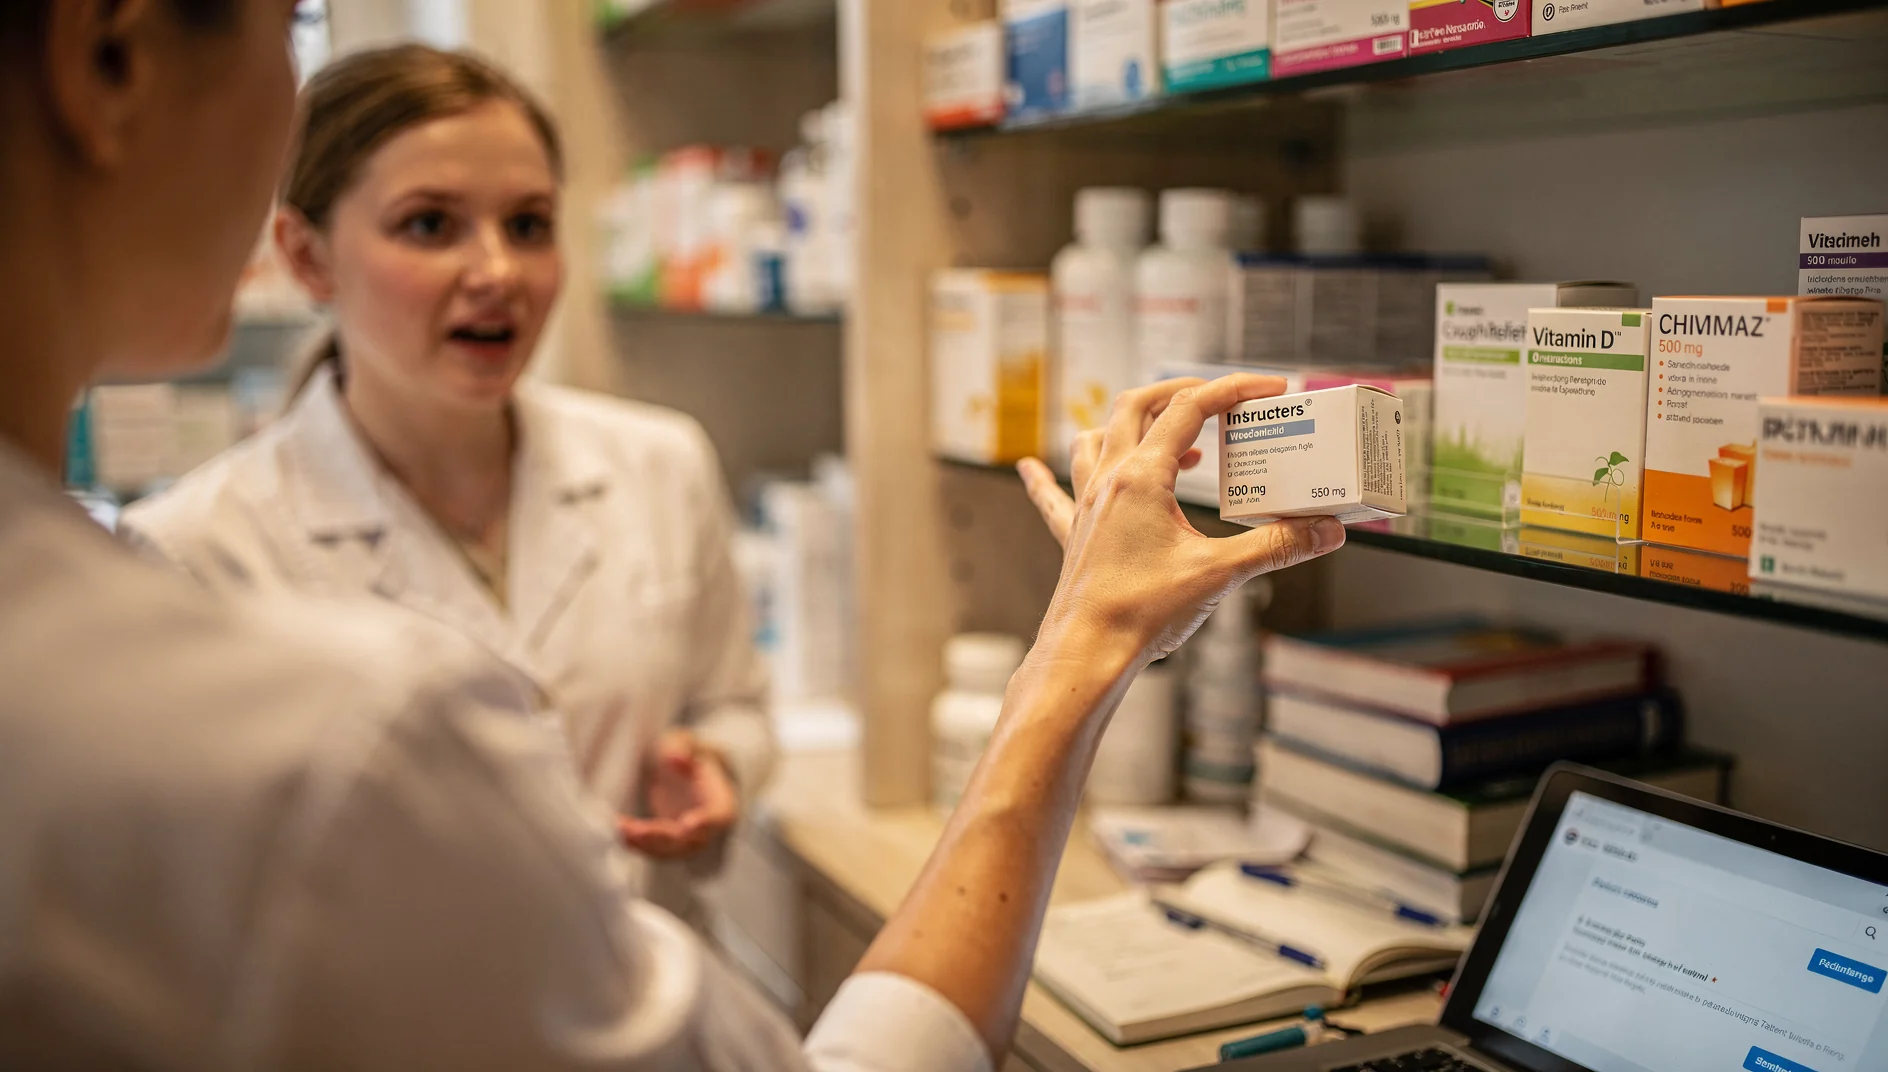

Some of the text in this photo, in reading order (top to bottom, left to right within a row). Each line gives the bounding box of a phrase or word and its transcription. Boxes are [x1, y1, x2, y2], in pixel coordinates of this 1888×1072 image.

[1533, 327, 1596, 348] Vitamin
[1659, 340, 1703, 357] 500 mg
[1228, 485, 1266, 497] 500 mg
[1332, 488, 1346, 498] mg
